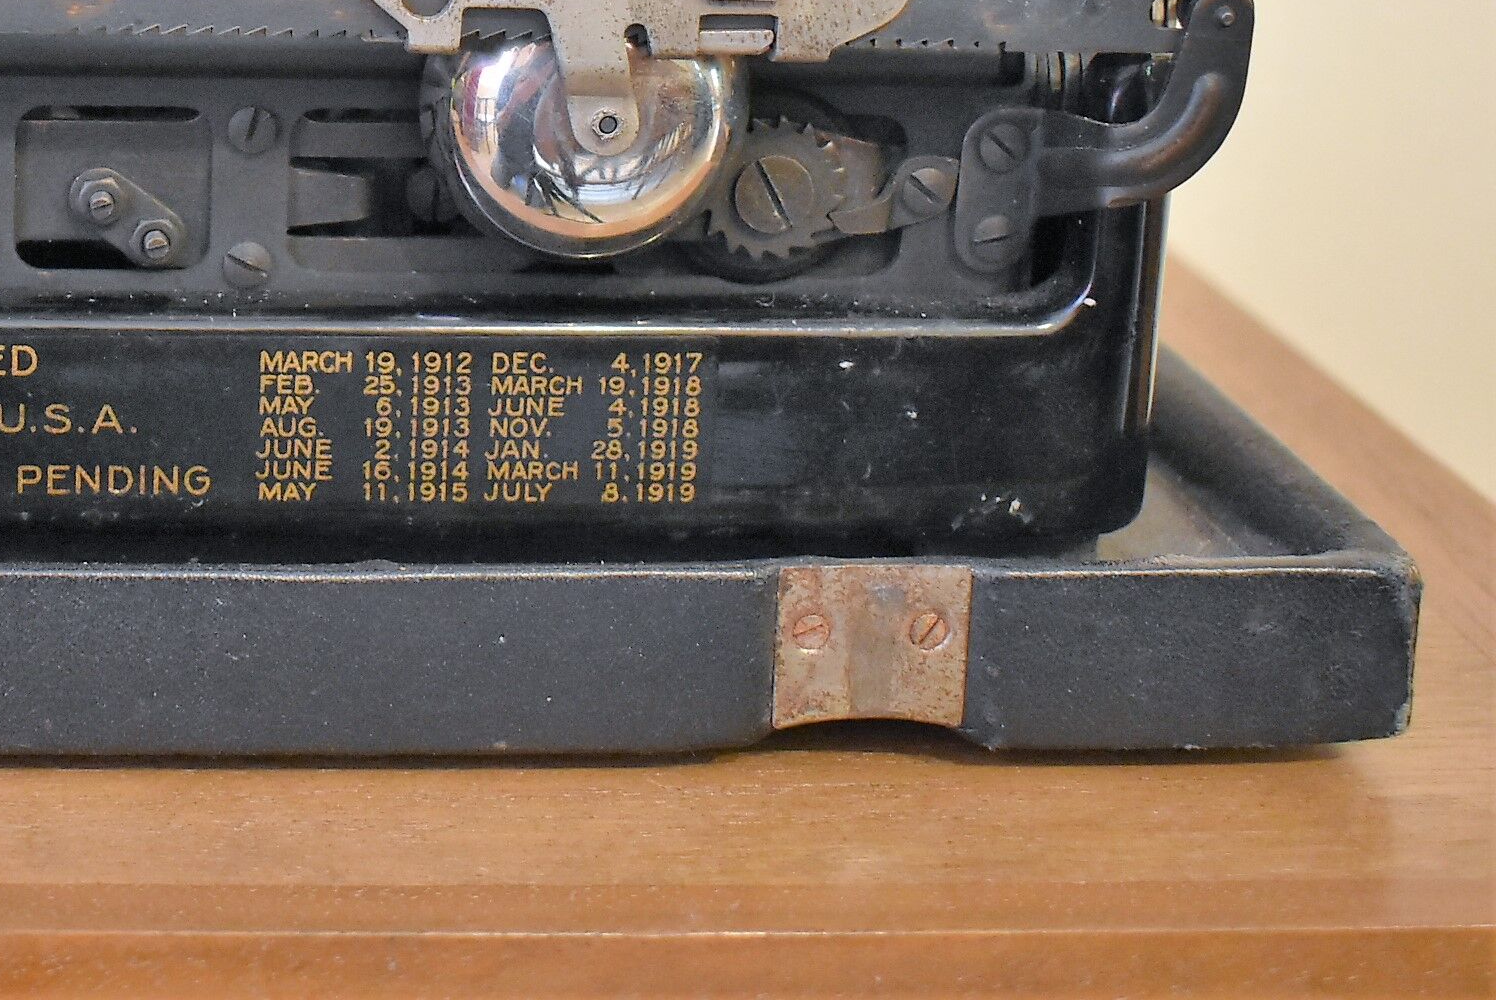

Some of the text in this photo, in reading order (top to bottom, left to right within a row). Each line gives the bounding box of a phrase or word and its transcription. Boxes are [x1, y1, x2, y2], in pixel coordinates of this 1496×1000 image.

[259, 351, 352, 374] MARCH
[412, 352, 472, 374] 1912
[492, 352, 554, 374] DEC.
[643, 353, 702, 374] 1917
[260, 374, 320, 395] FEB.
[412, 375, 472, 395] 1913
[491, 376, 582, 396] MARCH
[642, 376, 701, 397] 1918
[259, 396, 315, 415] MAY
[411, 397, 470, 417] 1913
[488, 397, 565, 417] JUNE
[641, 398, 700, 418] 1918
[260, 417, 324, 438] AUG.
[411, 418, 470, 437] 1913
[489, 417, 551, 438] NOV.
[640, 418, 699, 438] 1918
[256, 439, 332, 460] JUNE
[409, 439, 469, 460] 1914
[484, 439, 549, 460] JAN.
[639, 440, 698, 460] 1919
[16, 464, 211, 496] PENDING
[255, 460, 333, 481] JUNE
[409, 461, 469, 481] 1914
[486, 461, 578, 481] MARCH
[638, 461, 697, 481] 1919
[258, 482, 316, 502] MAY
[408, 482, 468, 502] 1915
[483, 482, 552, 502] JULY
[637, 483, 696, 502] 1919
